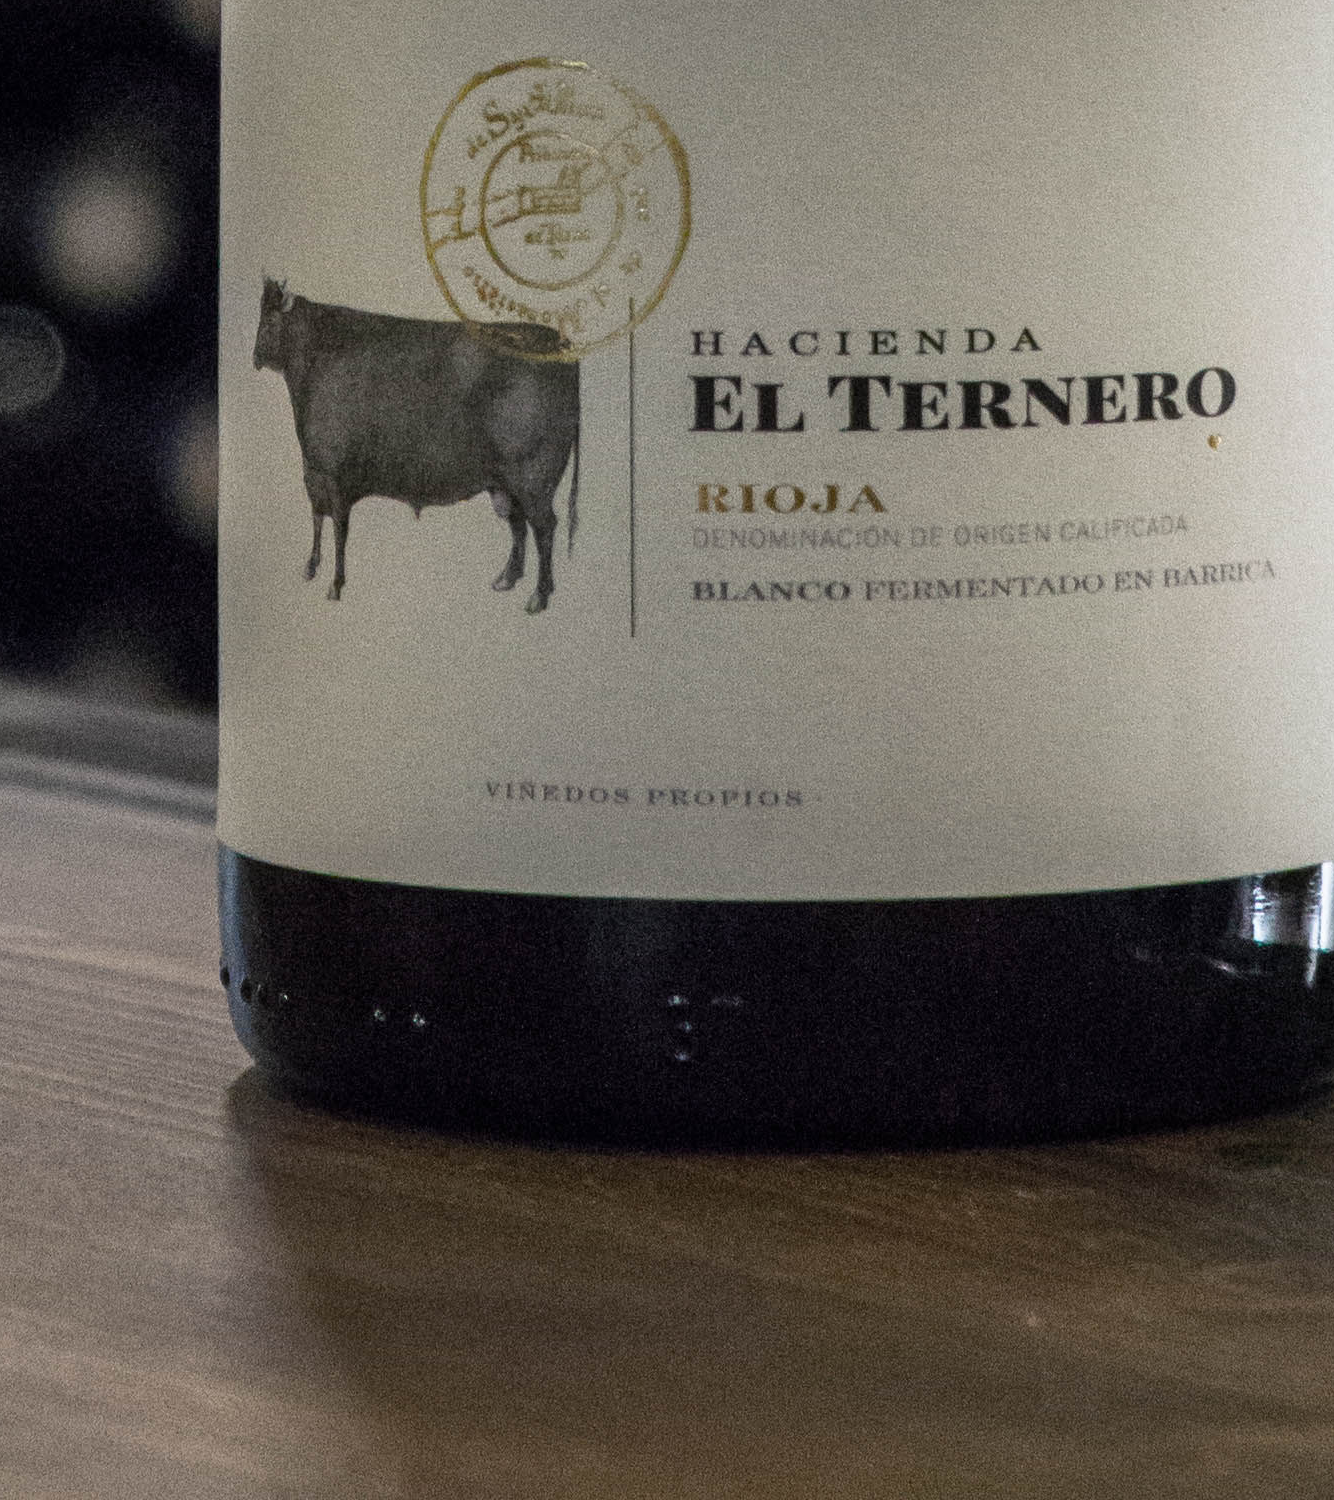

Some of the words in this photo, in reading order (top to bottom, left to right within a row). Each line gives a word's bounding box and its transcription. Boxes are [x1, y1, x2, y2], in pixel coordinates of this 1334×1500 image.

[691, 326, 1043, 356] HACIENDA
[687, 374, 805, 433] EL
[827, 366, 1236, 433] TERNERO
[694, 483, 889, 515] RIOJA
[910, 528, 944, 548] DE
[953, 521, 1053, 547] ORIGEN
[1059, 514, 1190, 544] CALIFICADA
[692, 580, 851, 602] BLANCO
[865, 573, 1105, 602] FERMENTADO
[1114, 568, 1154, 592] EN
[1164, 559, 1276, 589] BARRICA
[647, 787, 804, 807] PROPIOS
